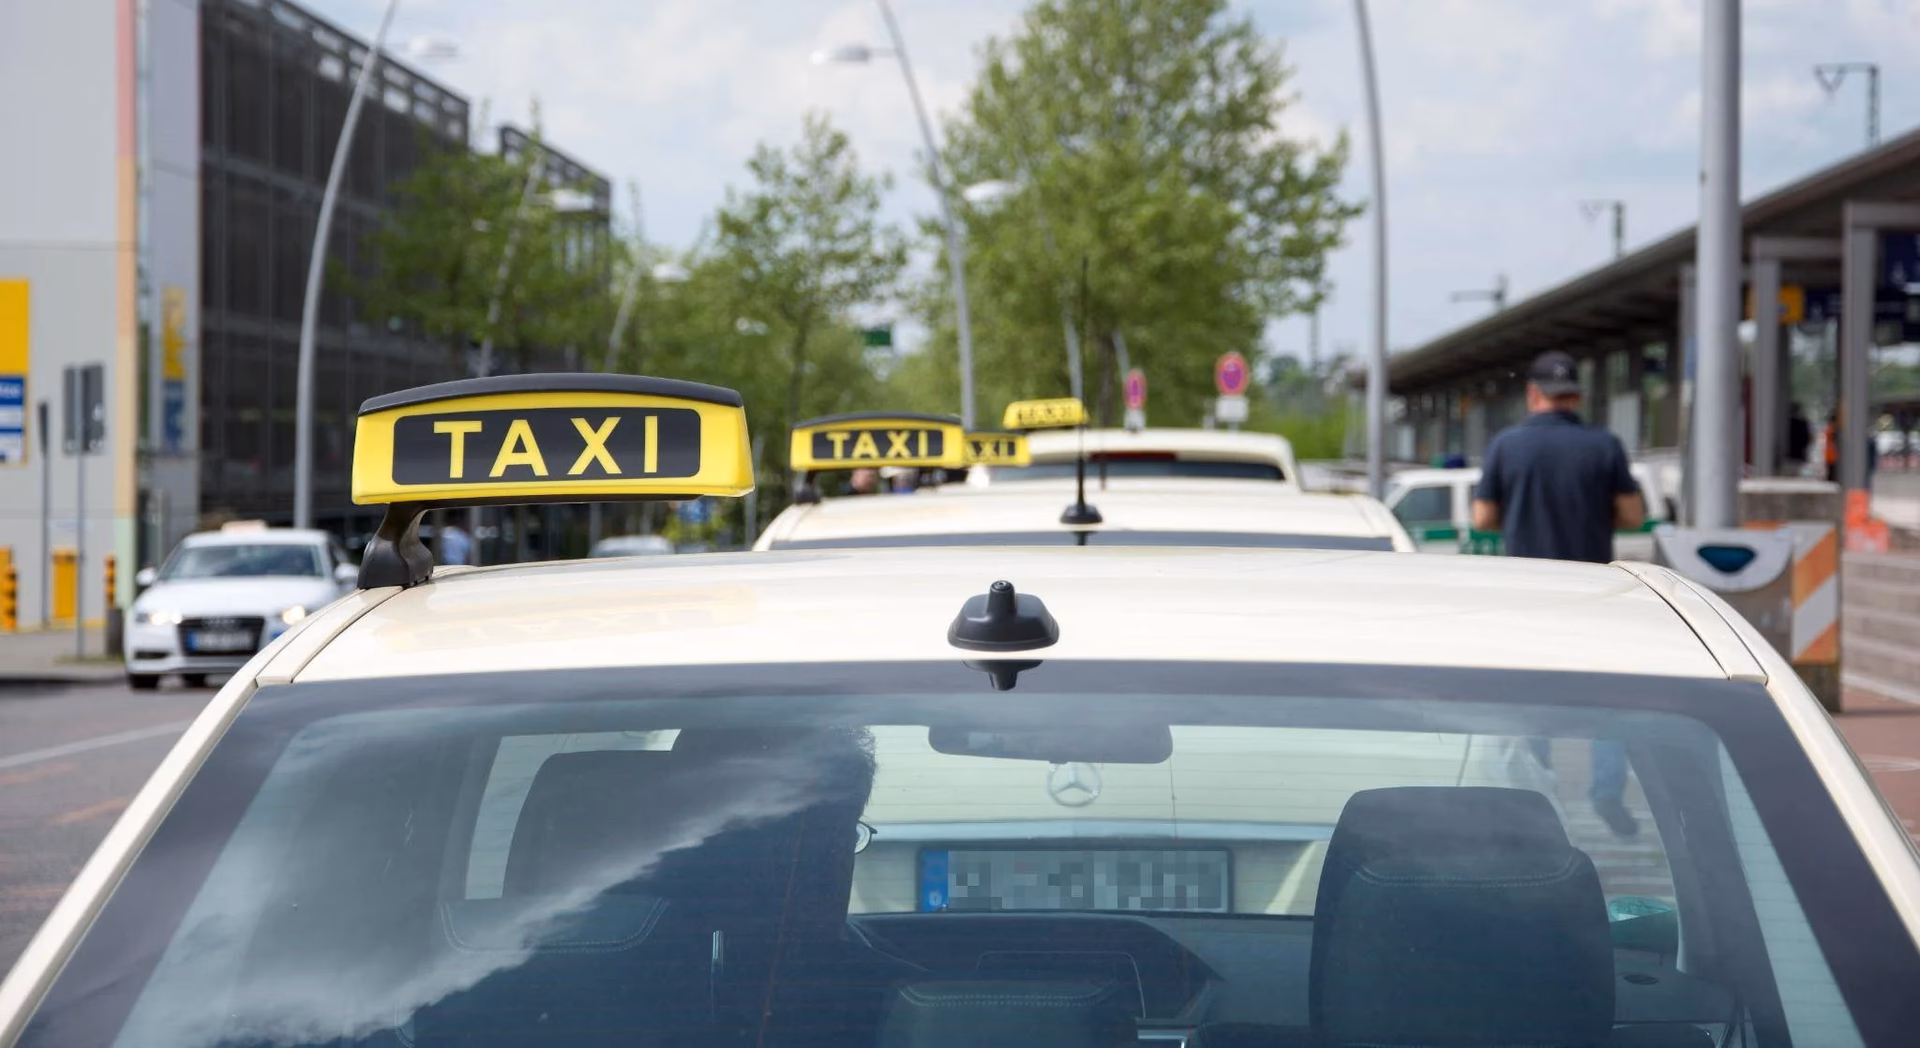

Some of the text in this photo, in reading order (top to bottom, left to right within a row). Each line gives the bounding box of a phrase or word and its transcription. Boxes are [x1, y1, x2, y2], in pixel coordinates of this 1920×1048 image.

[433, 415, 659, 479] TAXI
[826, 430, 929, 459] TAXI
[963, 438, 1008, 458] AXI
